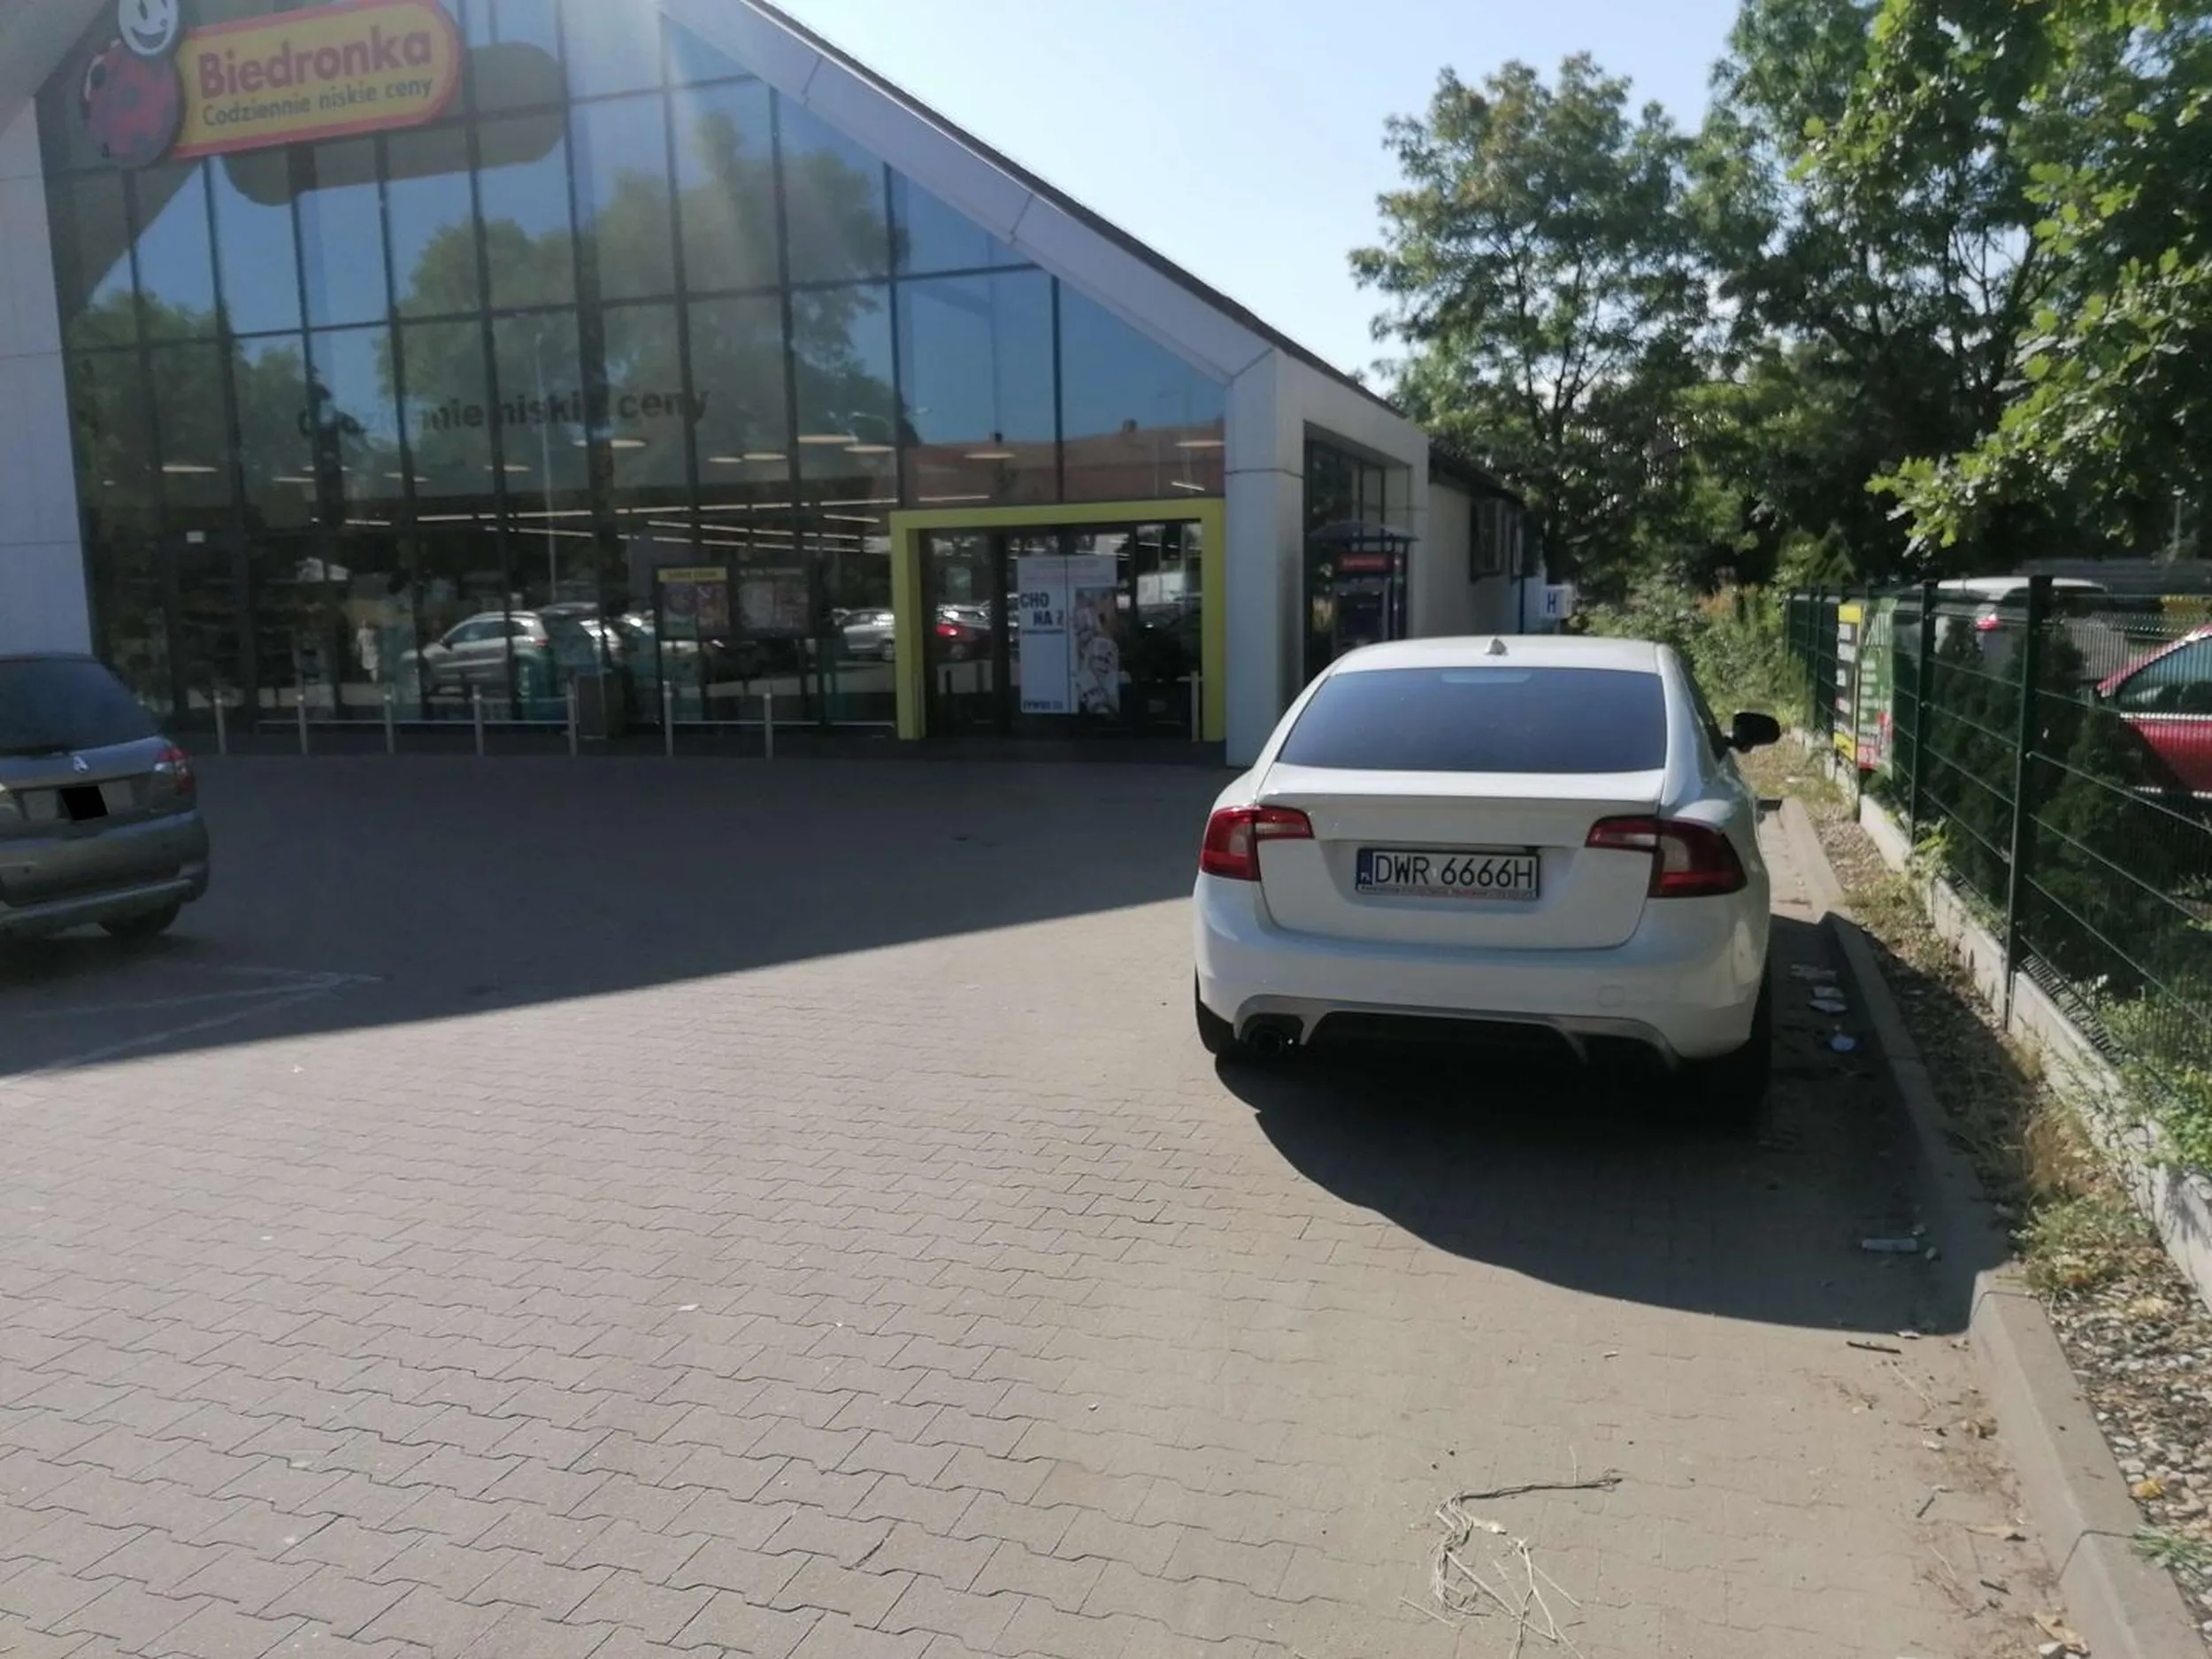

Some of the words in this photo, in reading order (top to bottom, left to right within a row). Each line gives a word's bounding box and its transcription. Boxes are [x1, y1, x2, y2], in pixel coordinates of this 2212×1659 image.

[198, 24, 432, 99] Biedronka
[203, 91, 311, 126] Codziennie
[319, 81, 377, 110] niskie
[385, 76, 433, 99] ceny
[1019, 592, 1049, 608] CHO
[1375, 855, 1430, 885] DWR
[1440, 857, 1533, 889] 6666H
